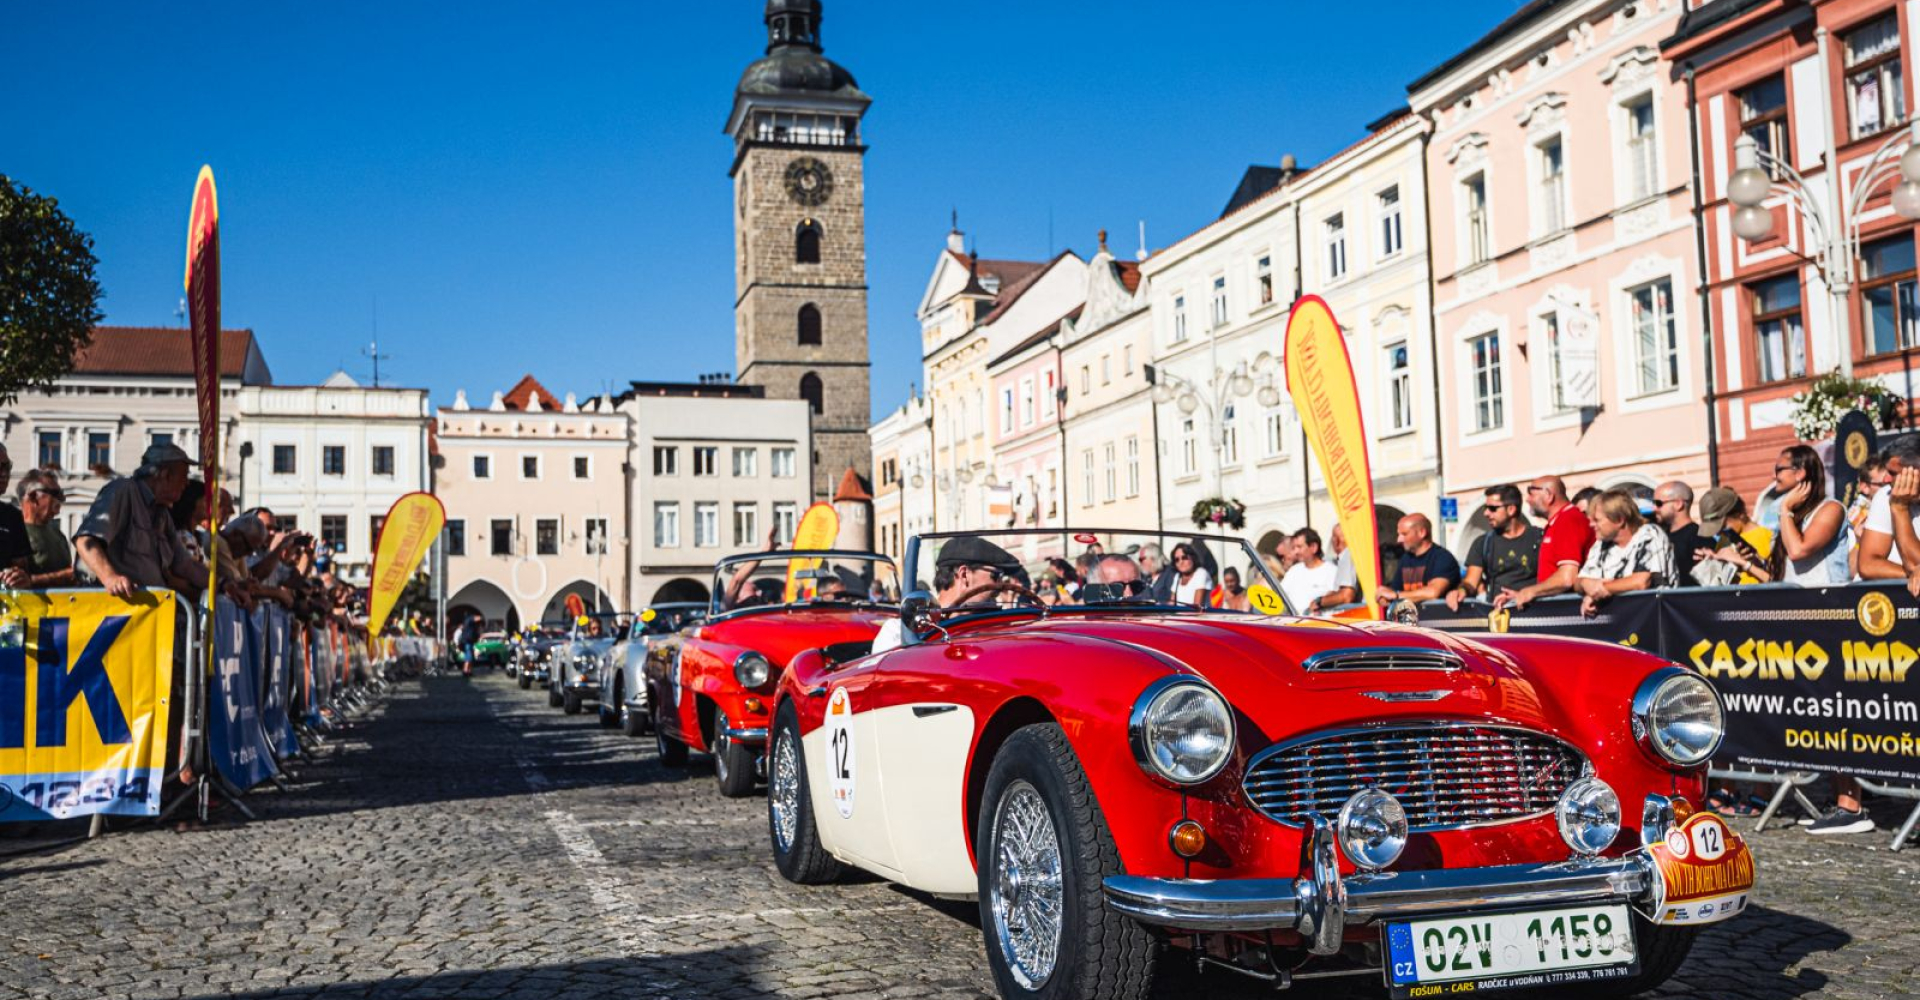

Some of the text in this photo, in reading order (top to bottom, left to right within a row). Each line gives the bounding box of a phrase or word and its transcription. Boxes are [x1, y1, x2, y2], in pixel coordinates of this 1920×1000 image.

[1257, 593, 1278, 609] 12
[1689, 637, 1920, 683] CASINO IMP
[832, 727, 850, 779] 12
[1785, 727, 1848, 751] DOLNÍ
[20, 776, 152, 810] 1234
[1700, 826, 1719, 854] 12
[1662, 859, 1694, 898] SOUTH
[1696, 862, 1727, 893] BOHEMIA
[1424, 912, 1615, 973] 02V 1158
[1395, 962, 1414, 977] CZ
[1410, 985, 1442, 997] FOŠUM
[1451, 981, 1475, 993] CARS
